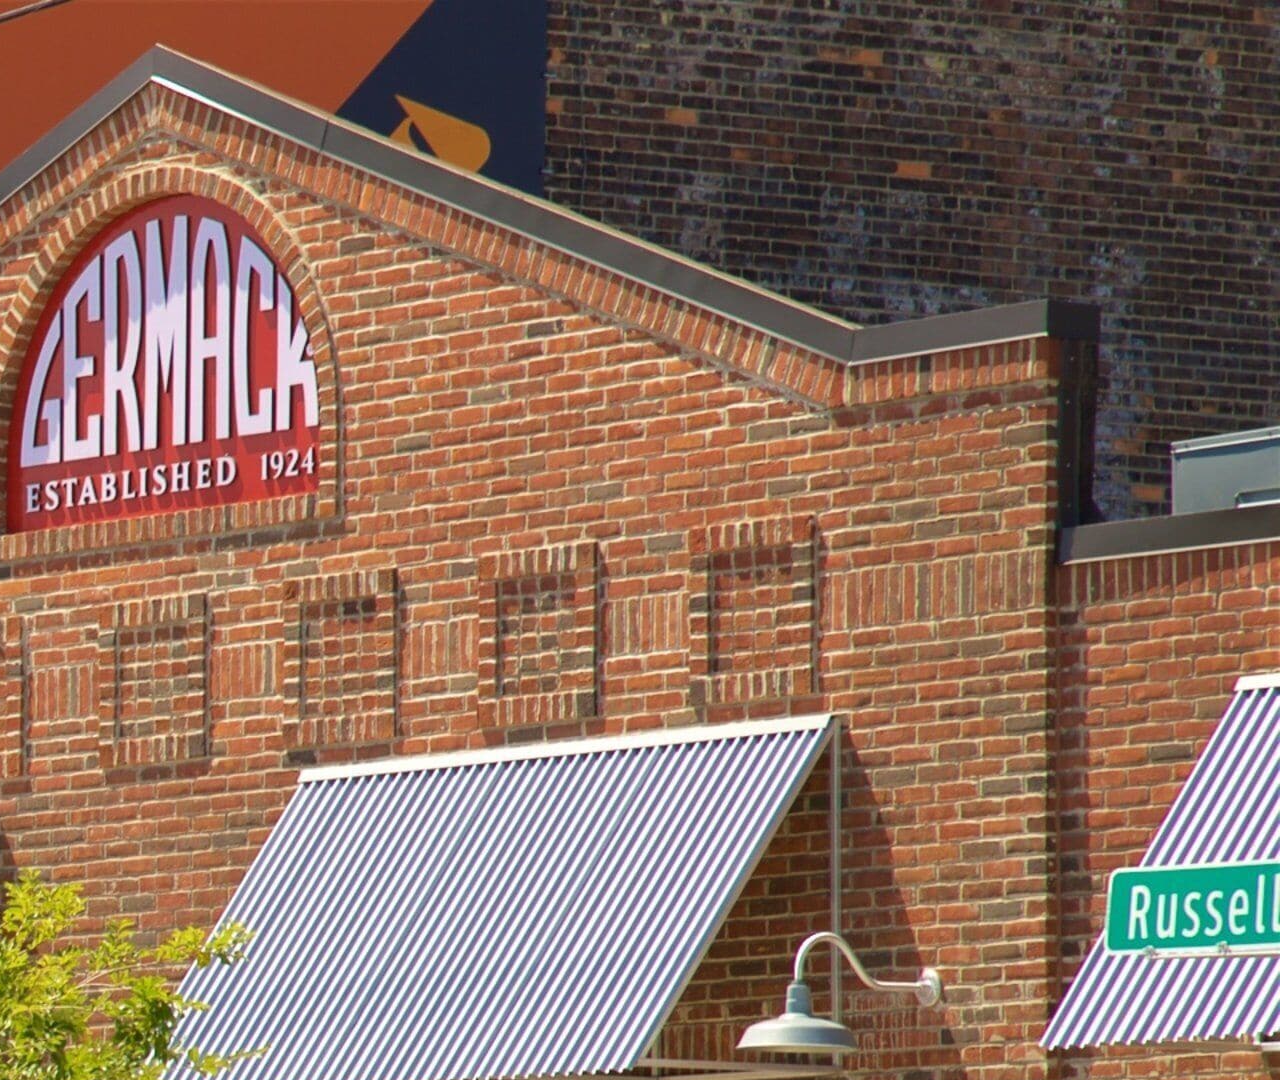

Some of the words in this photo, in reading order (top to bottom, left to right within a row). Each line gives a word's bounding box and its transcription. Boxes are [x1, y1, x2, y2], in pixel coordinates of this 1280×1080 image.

[20, 215, 320, 468] GERMACK
[26, 456, 237, 513] ESTABLISHED
[260, 446, 316, 481] 1924
